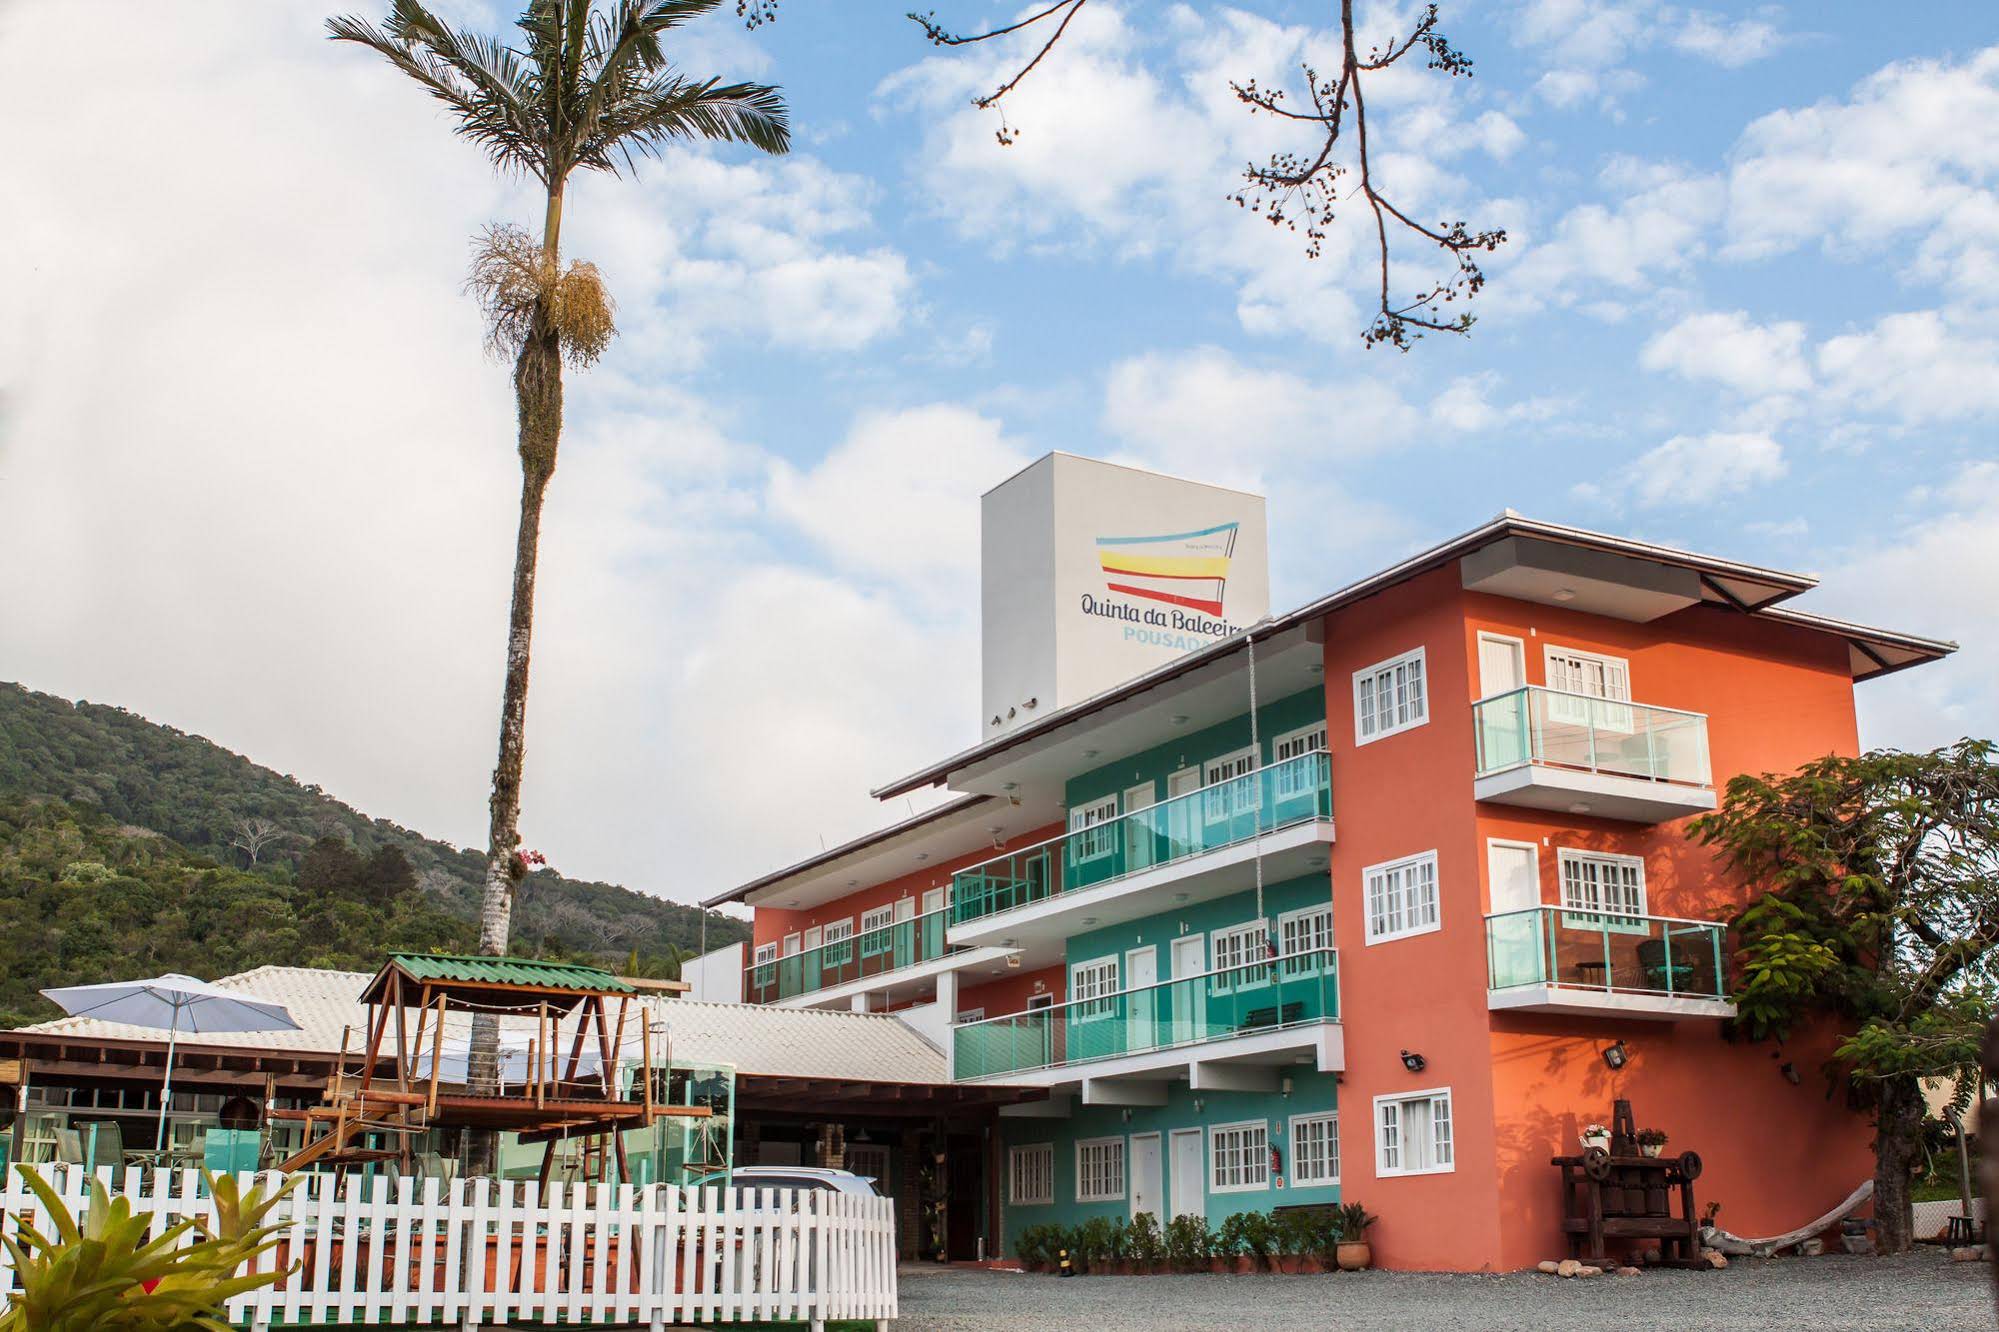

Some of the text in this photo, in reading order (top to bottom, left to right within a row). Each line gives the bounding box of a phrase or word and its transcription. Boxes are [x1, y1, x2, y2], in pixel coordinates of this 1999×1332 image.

[1081, 594, 1243, 637] Quinta da Baleeir
